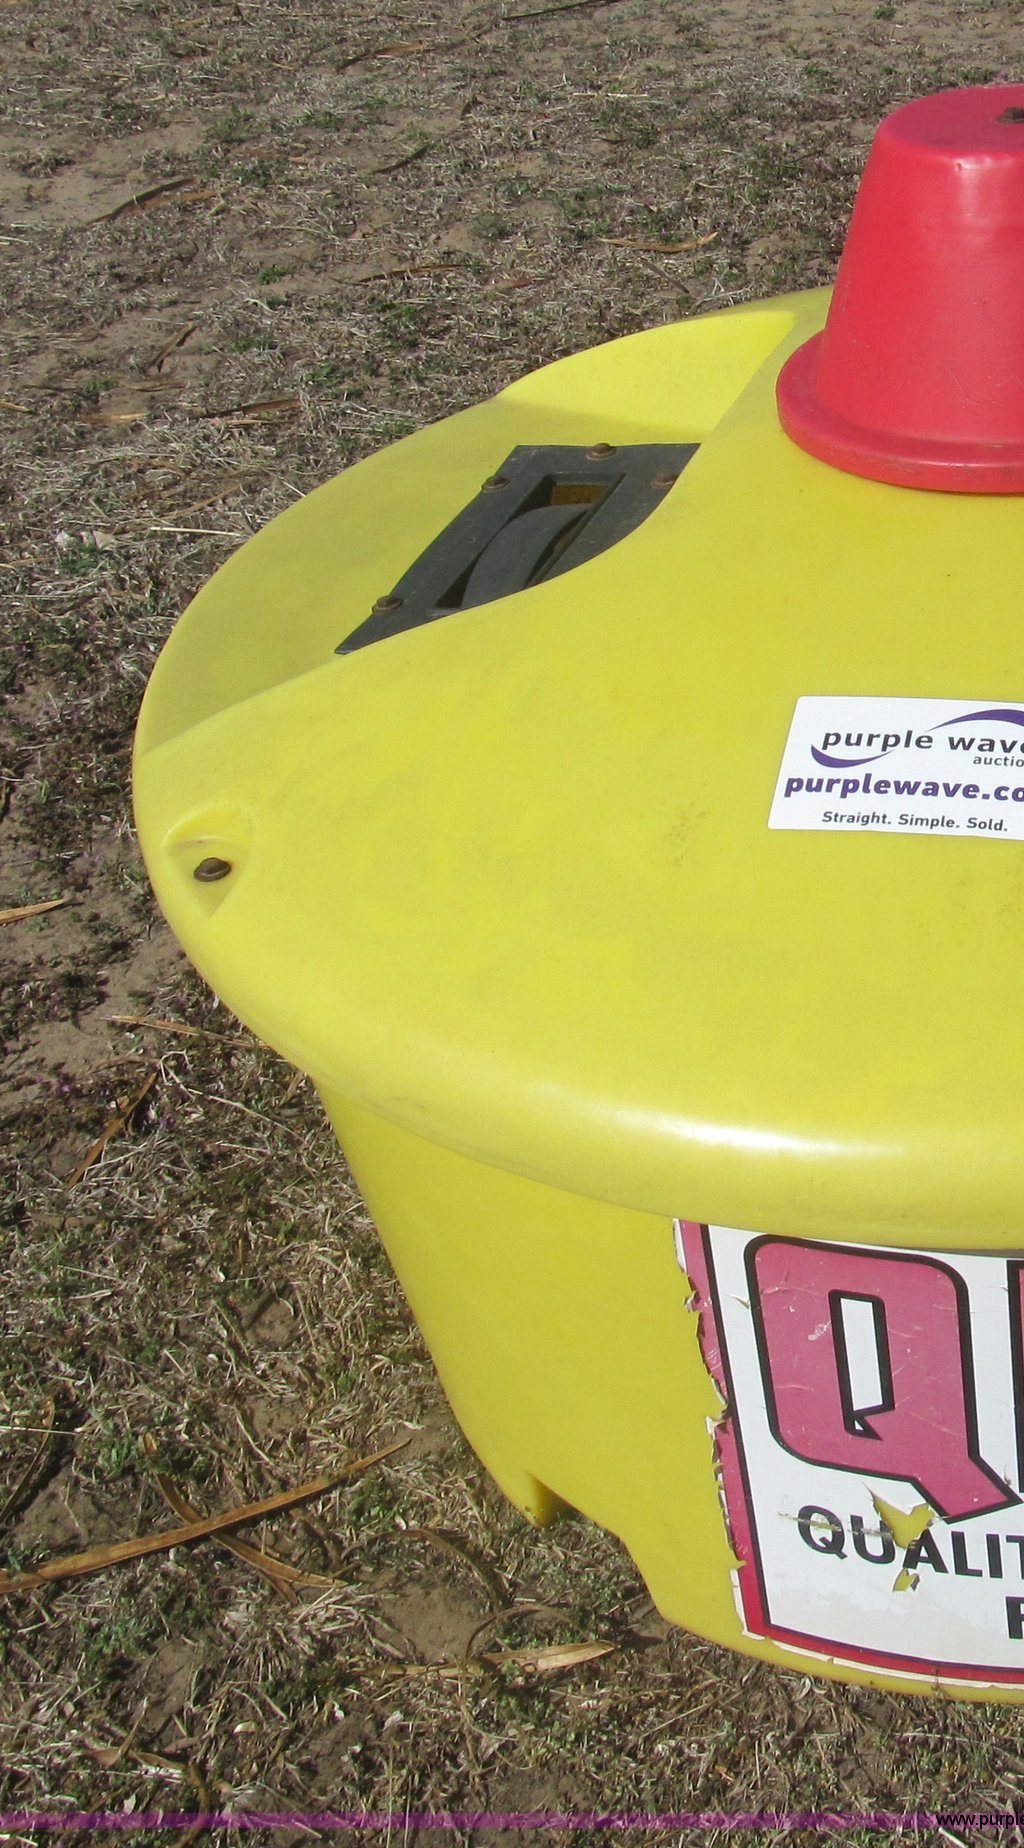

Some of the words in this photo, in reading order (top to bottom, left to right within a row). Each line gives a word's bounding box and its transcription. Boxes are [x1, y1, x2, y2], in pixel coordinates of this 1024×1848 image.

[822, 730, 934, 752] purple
[822, 811, 891, 826] Straight.
[898, 814, 960, 829] Simple.
[966, 817, 1008, 831] Sold.
